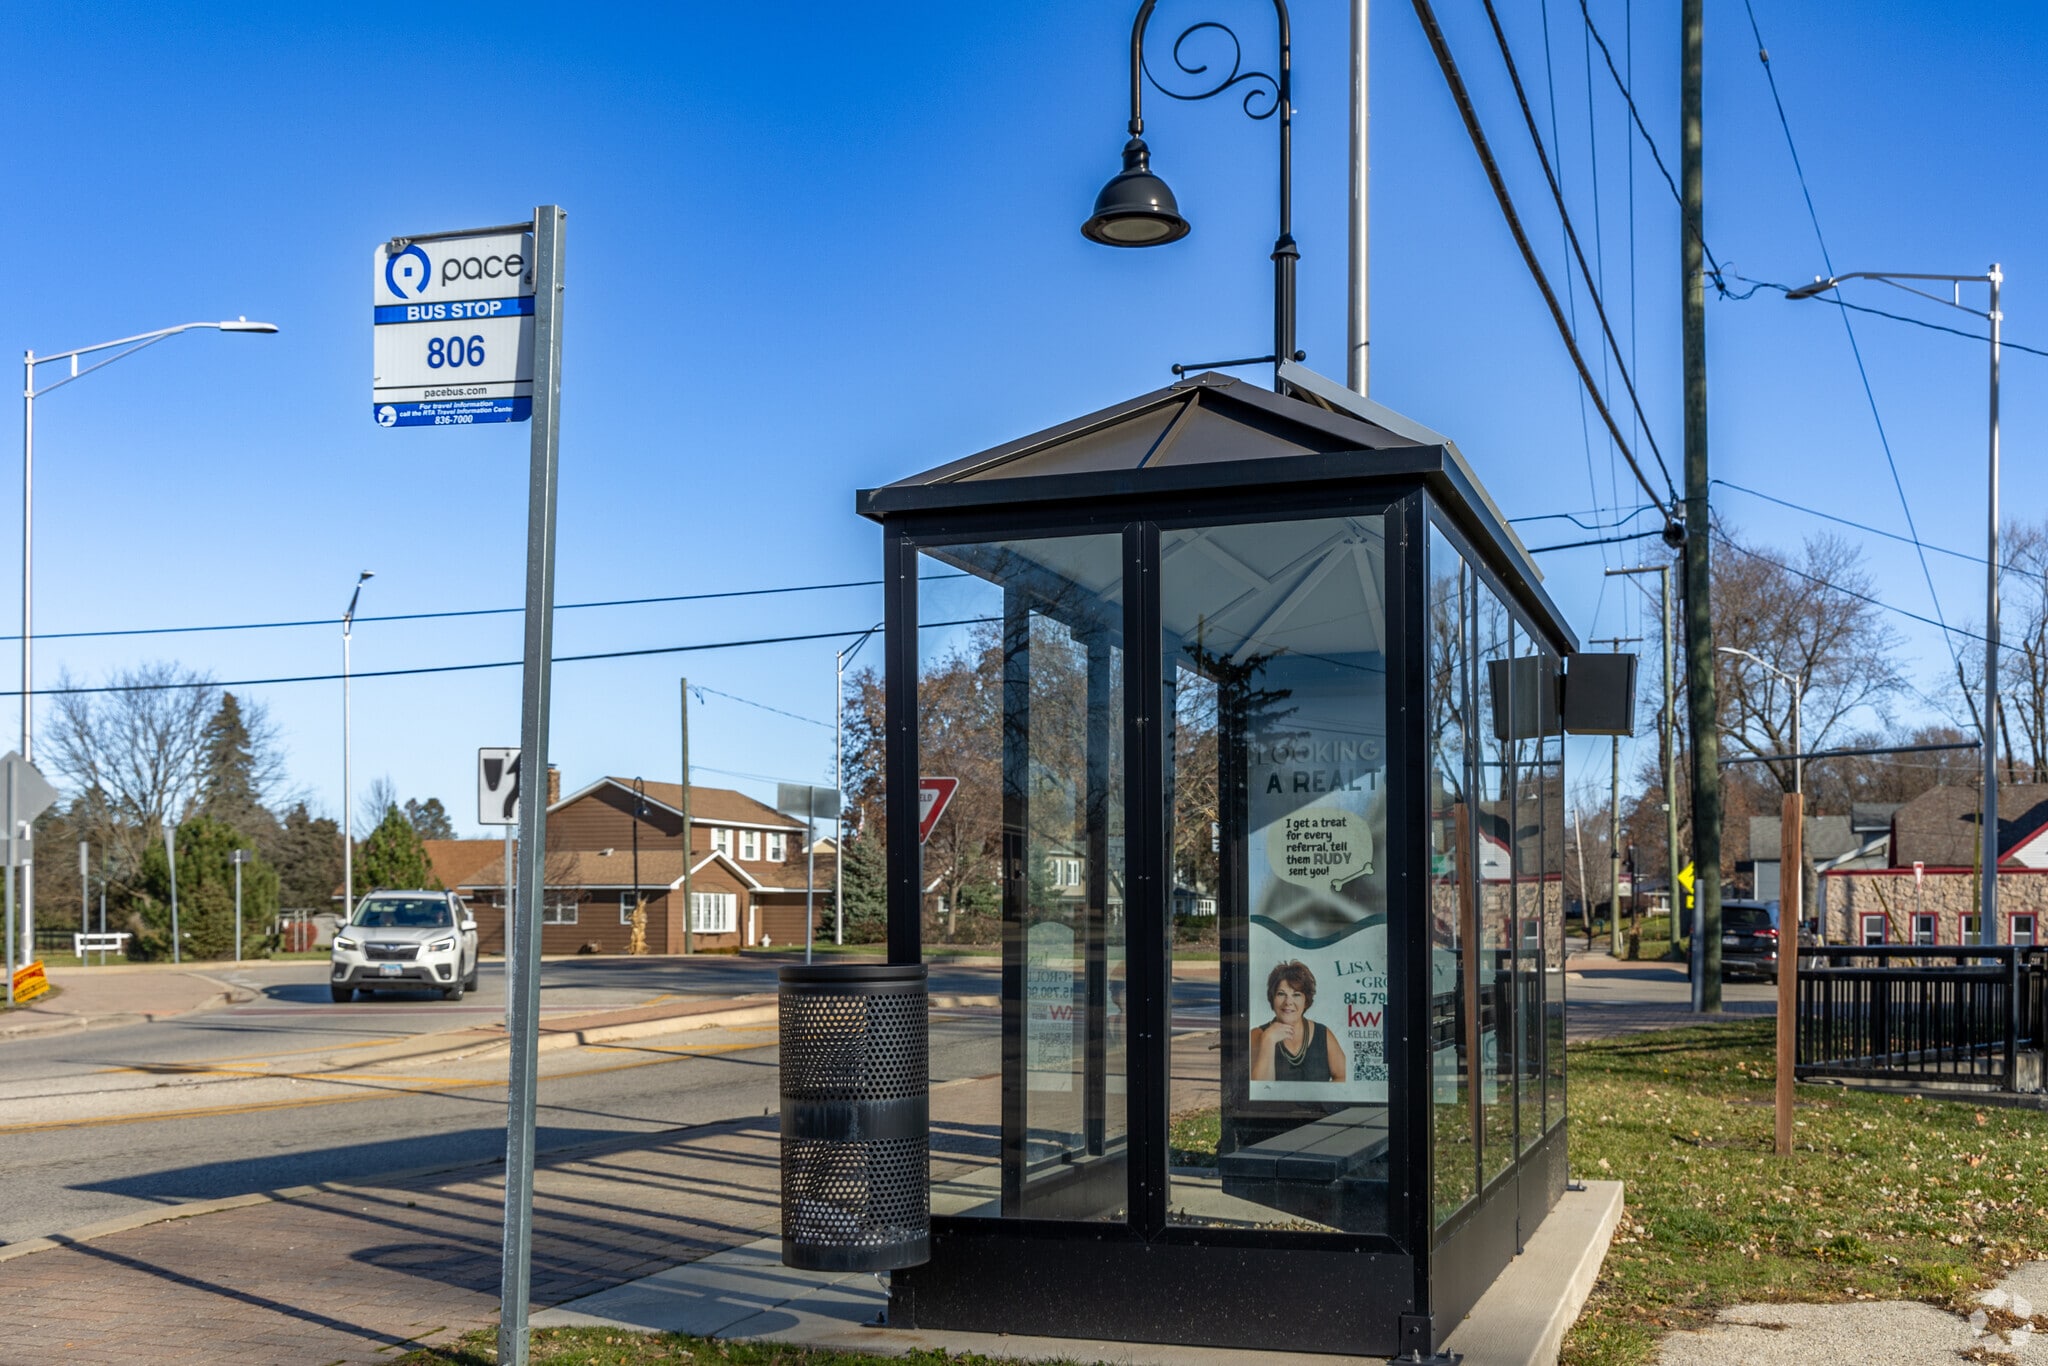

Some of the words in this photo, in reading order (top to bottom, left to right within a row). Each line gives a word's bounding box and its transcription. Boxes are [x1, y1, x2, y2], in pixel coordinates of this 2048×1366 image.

[441, 254, 524, 287] pace
[407, 306, 446, 321] BUS
[451, 301, 501, 318] STOP
[427, 335, 485, 369] 806
[424, 387, 487, 399] pacebus.com
[435, 415, 473, 424] 836-7000
[1258, 740, 1379, 765] LOOKING
[1266, 772, 1282, 794] A
[1293, 768, 1387, 793] REALT
[1286, 818, 1291, 828] I
[1293, 818, 1310, 831] get
[1320, 817, 1347, 828] treat
[1286, 830, 1302, 840] for
[1304, 832, 1332, 842] every
[1330, 841, 1348, 852] tell
[1286, 854, 1311, 865] them
[1314, 852, 1352, 865] RUDY
[1289, 866, 1308, 876] sent
[1310, 866, 1330, 878] you!
[1344, 992, 1386, 1005] 815.79
[1348, 1003, 1382, 1028] kw
